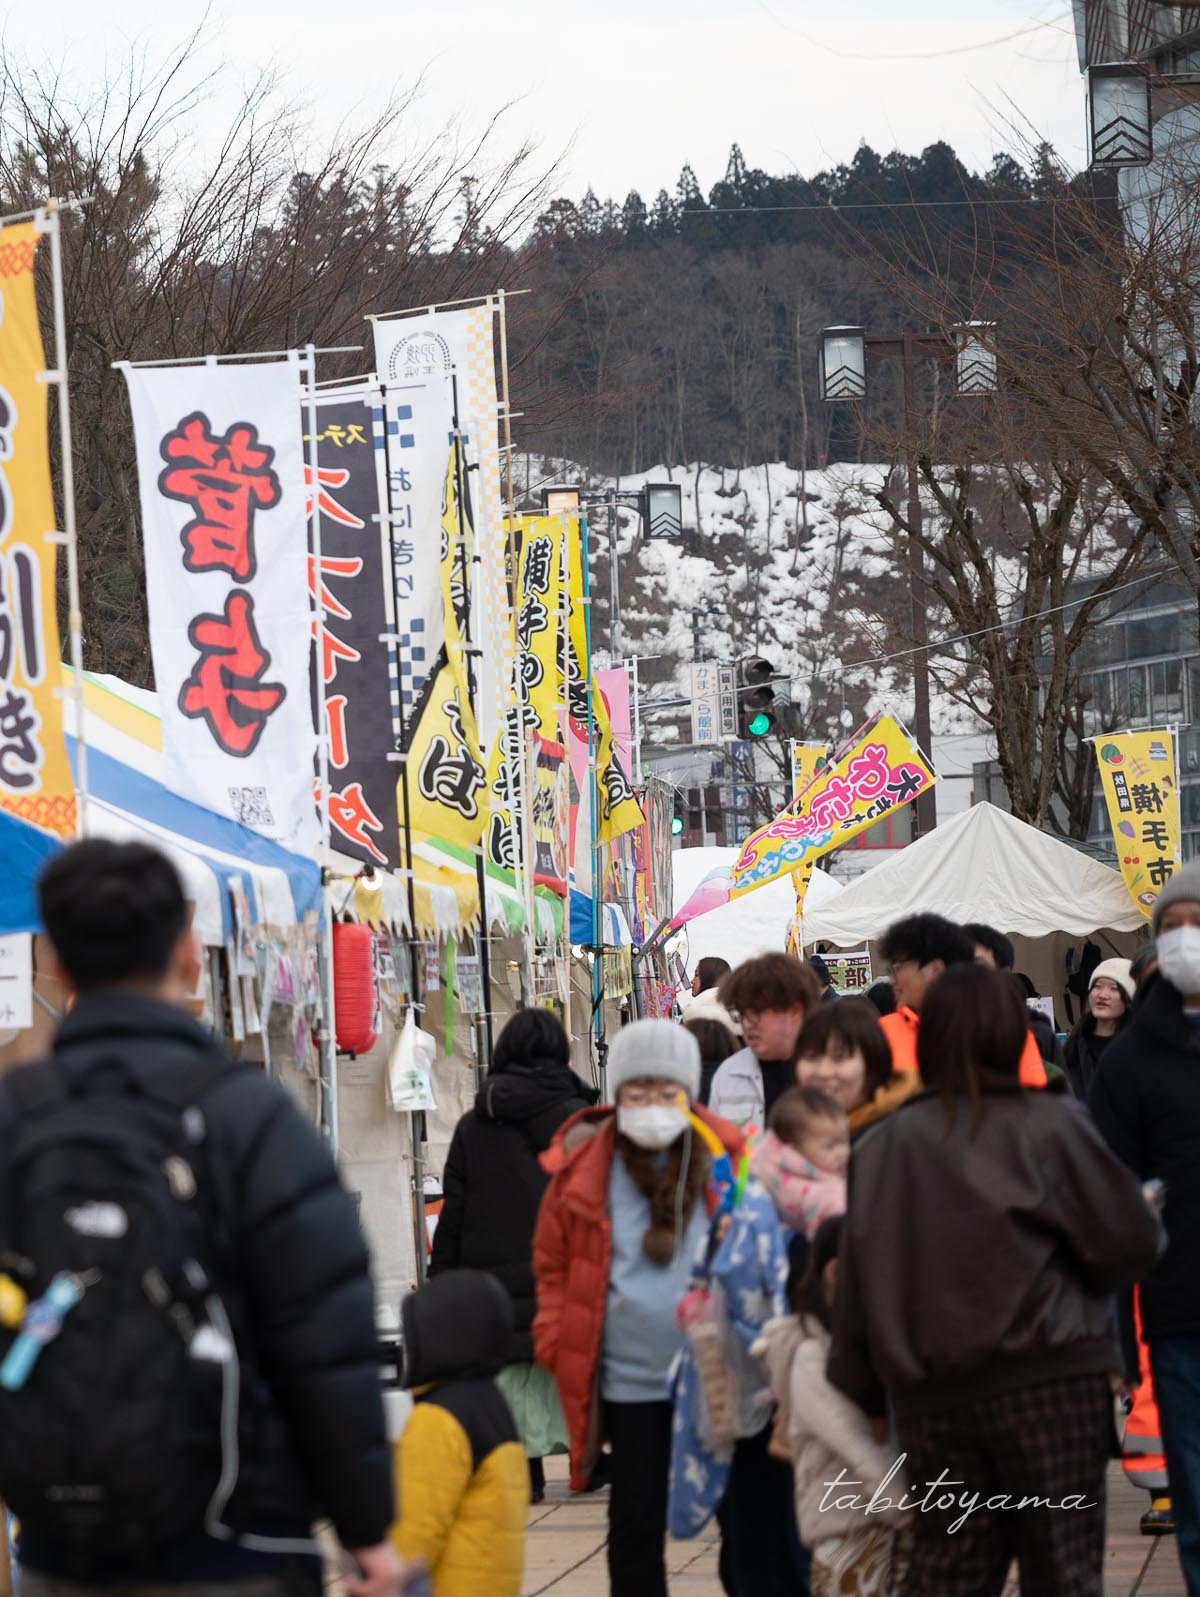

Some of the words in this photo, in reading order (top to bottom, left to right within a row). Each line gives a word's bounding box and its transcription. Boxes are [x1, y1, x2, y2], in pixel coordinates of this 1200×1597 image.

[696, 667, 712, 740] かまくら館前
